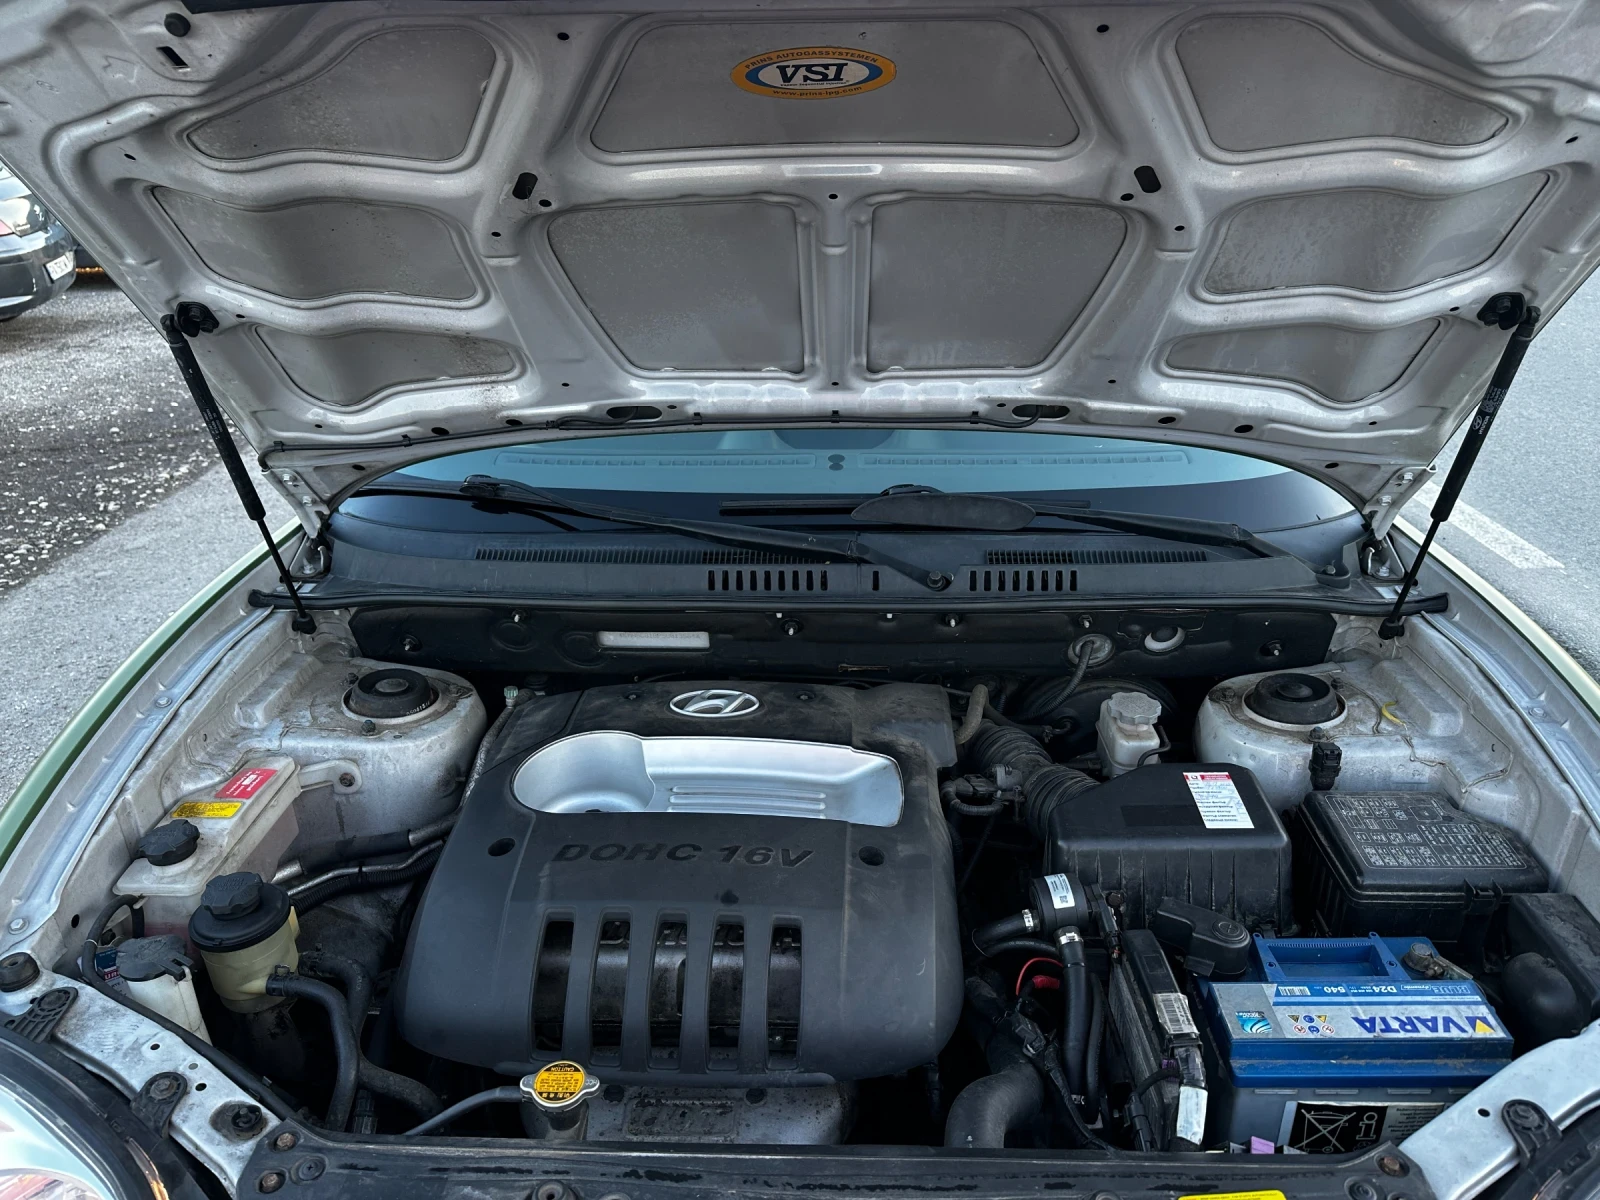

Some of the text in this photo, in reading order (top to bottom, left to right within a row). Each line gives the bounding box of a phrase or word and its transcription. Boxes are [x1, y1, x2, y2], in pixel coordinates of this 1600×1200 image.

[745, 51, 879, 69] PRINS AUTOGASSYSTEMEN
[776, 62, 849, 83] VSI
[773, 86, 863, 97] www.prins-lpg.com
[551, 843, 815, 868] DOHC 16V
[1323, 985, 1346, 993] 540
[1372, 985, 1398, 993] D24
[1351, 1016, 1469, 1034] VARTA
